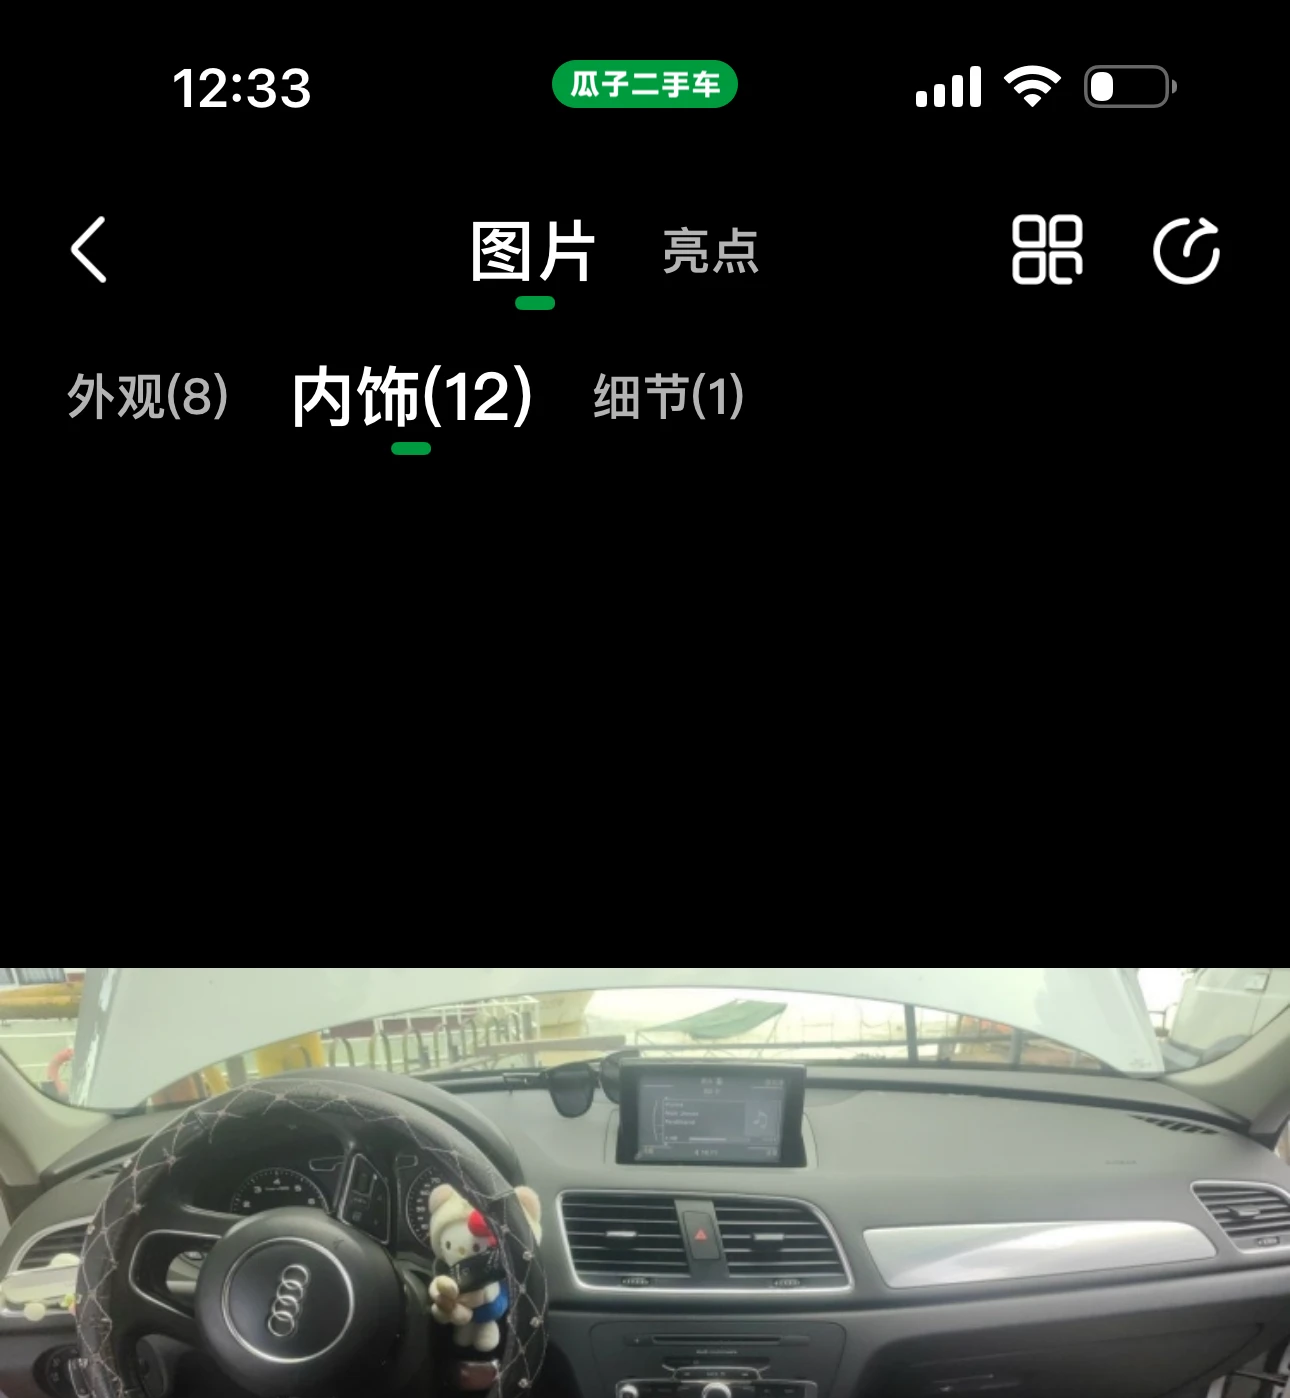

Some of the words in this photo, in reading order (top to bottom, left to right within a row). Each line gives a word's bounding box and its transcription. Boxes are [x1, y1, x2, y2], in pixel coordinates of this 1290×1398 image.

[173, 67, 311, 109] 12:33
[570, 70, 721, 99] 瓜子二手车
[472, 219, 595, 282] 图片
[663, 226, 759, 274] 亮点
[67, 372, 228, 420] 外观(8)
[294, 364, 531, 428] 内饰(12)
[593, 372, 744, 420] 细节(1)
